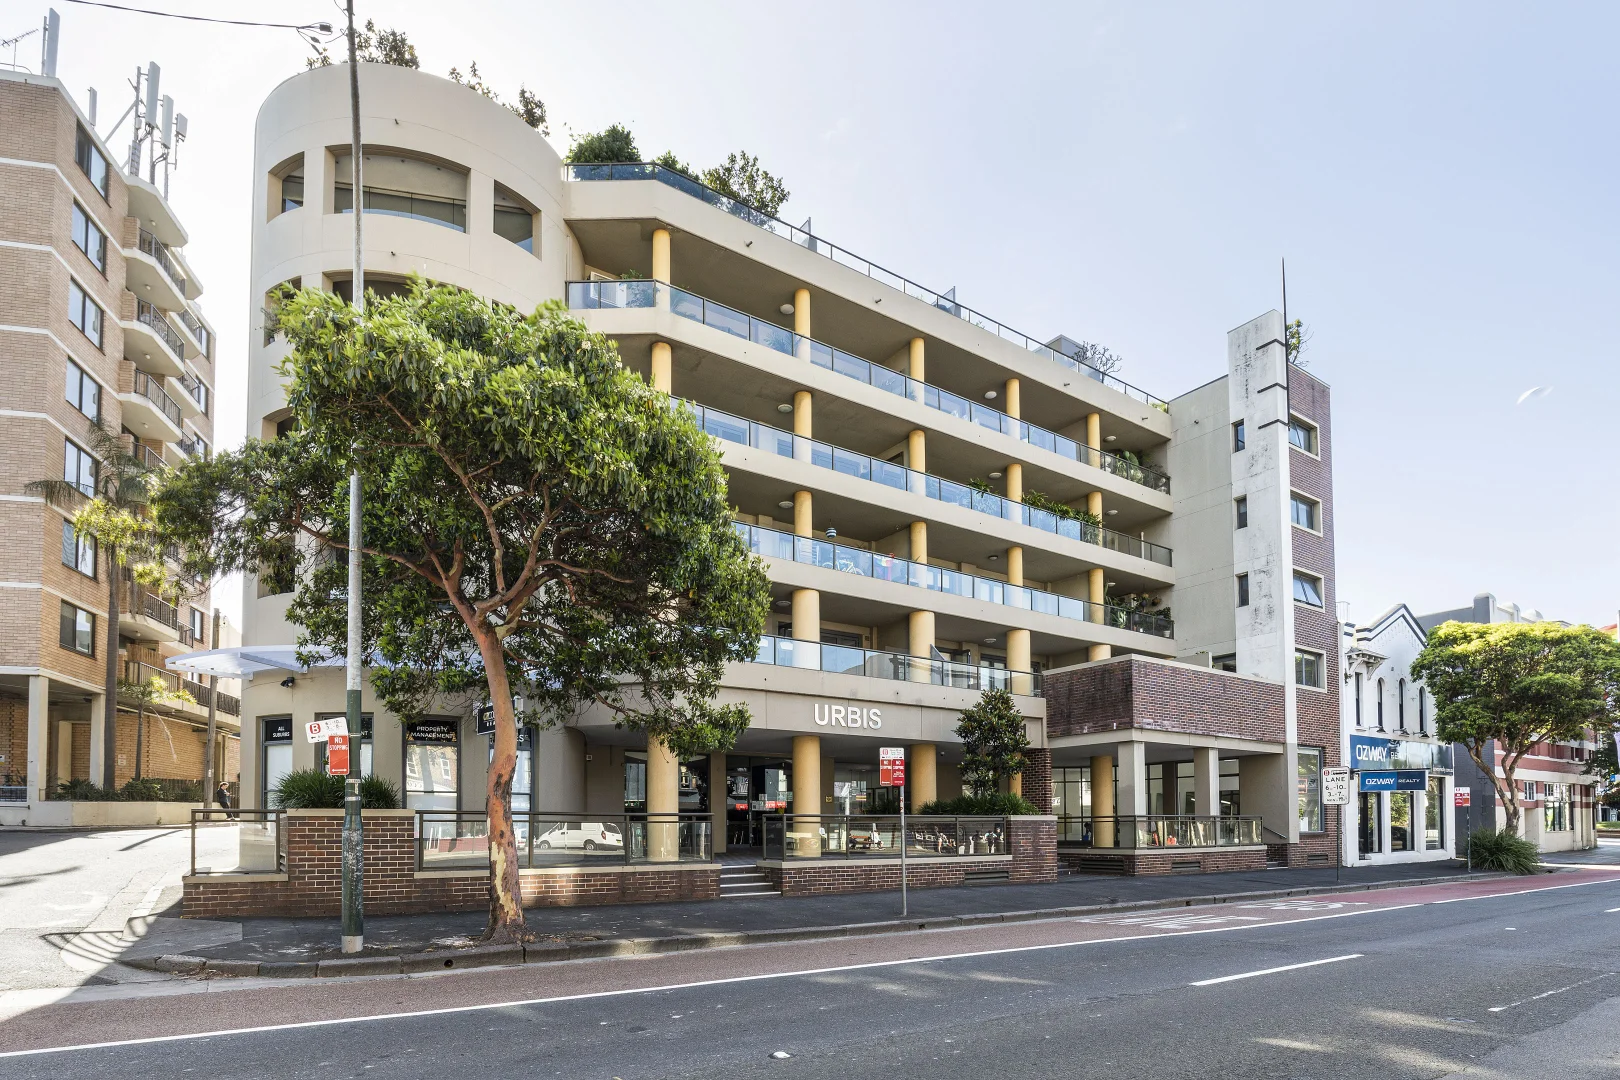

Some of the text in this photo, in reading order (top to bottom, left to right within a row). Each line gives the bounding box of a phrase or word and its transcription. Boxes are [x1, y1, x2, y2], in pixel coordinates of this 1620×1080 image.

[814, 703, 881, 730] URBIS
[311, 724, 319, 733] B
[1355, 744, 1388, 762] OZWAY
